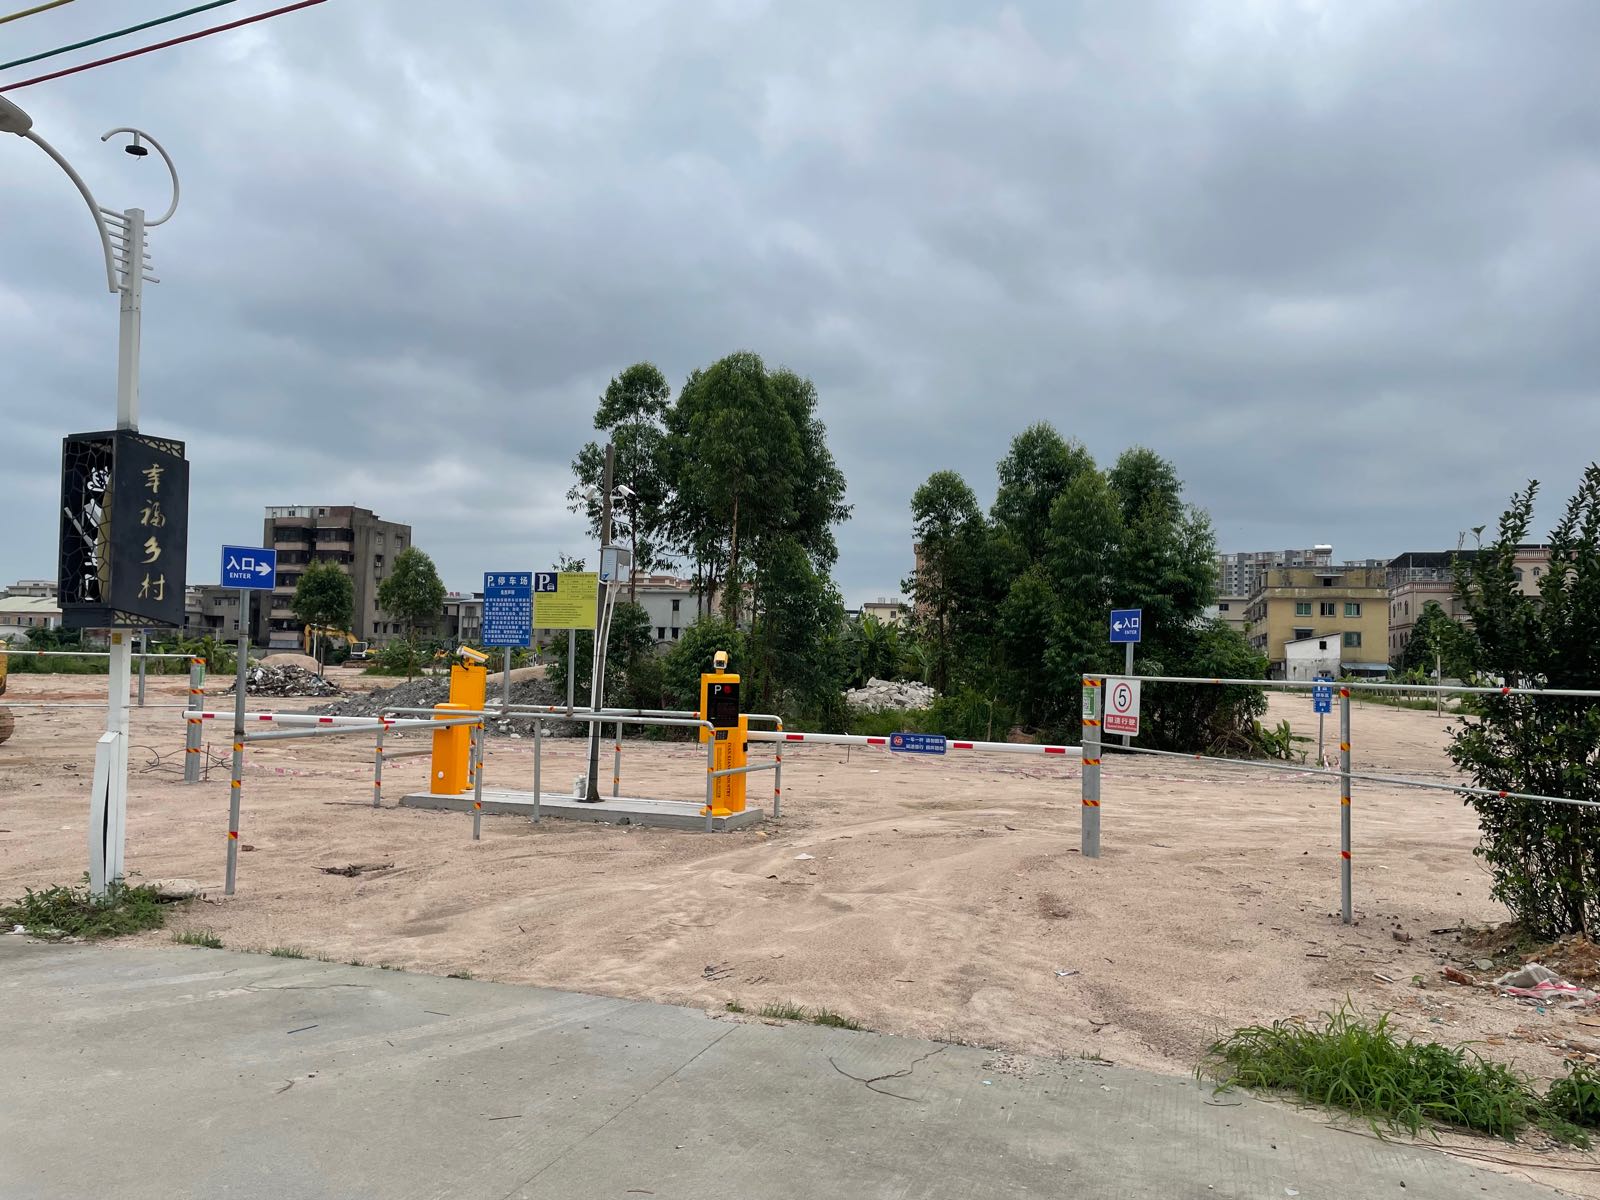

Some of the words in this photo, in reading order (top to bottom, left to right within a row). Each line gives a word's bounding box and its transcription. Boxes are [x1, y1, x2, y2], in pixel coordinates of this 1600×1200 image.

[138, 463, 166, 601] 幸福乡村
[226, 555, 255, 572] 入口
[498, 576, 528, 586] 停车场
[537, 573, 551, 591] P
[1123, 617, 1139, 628] 入口
[1118, 689, 1127, 707] 5
